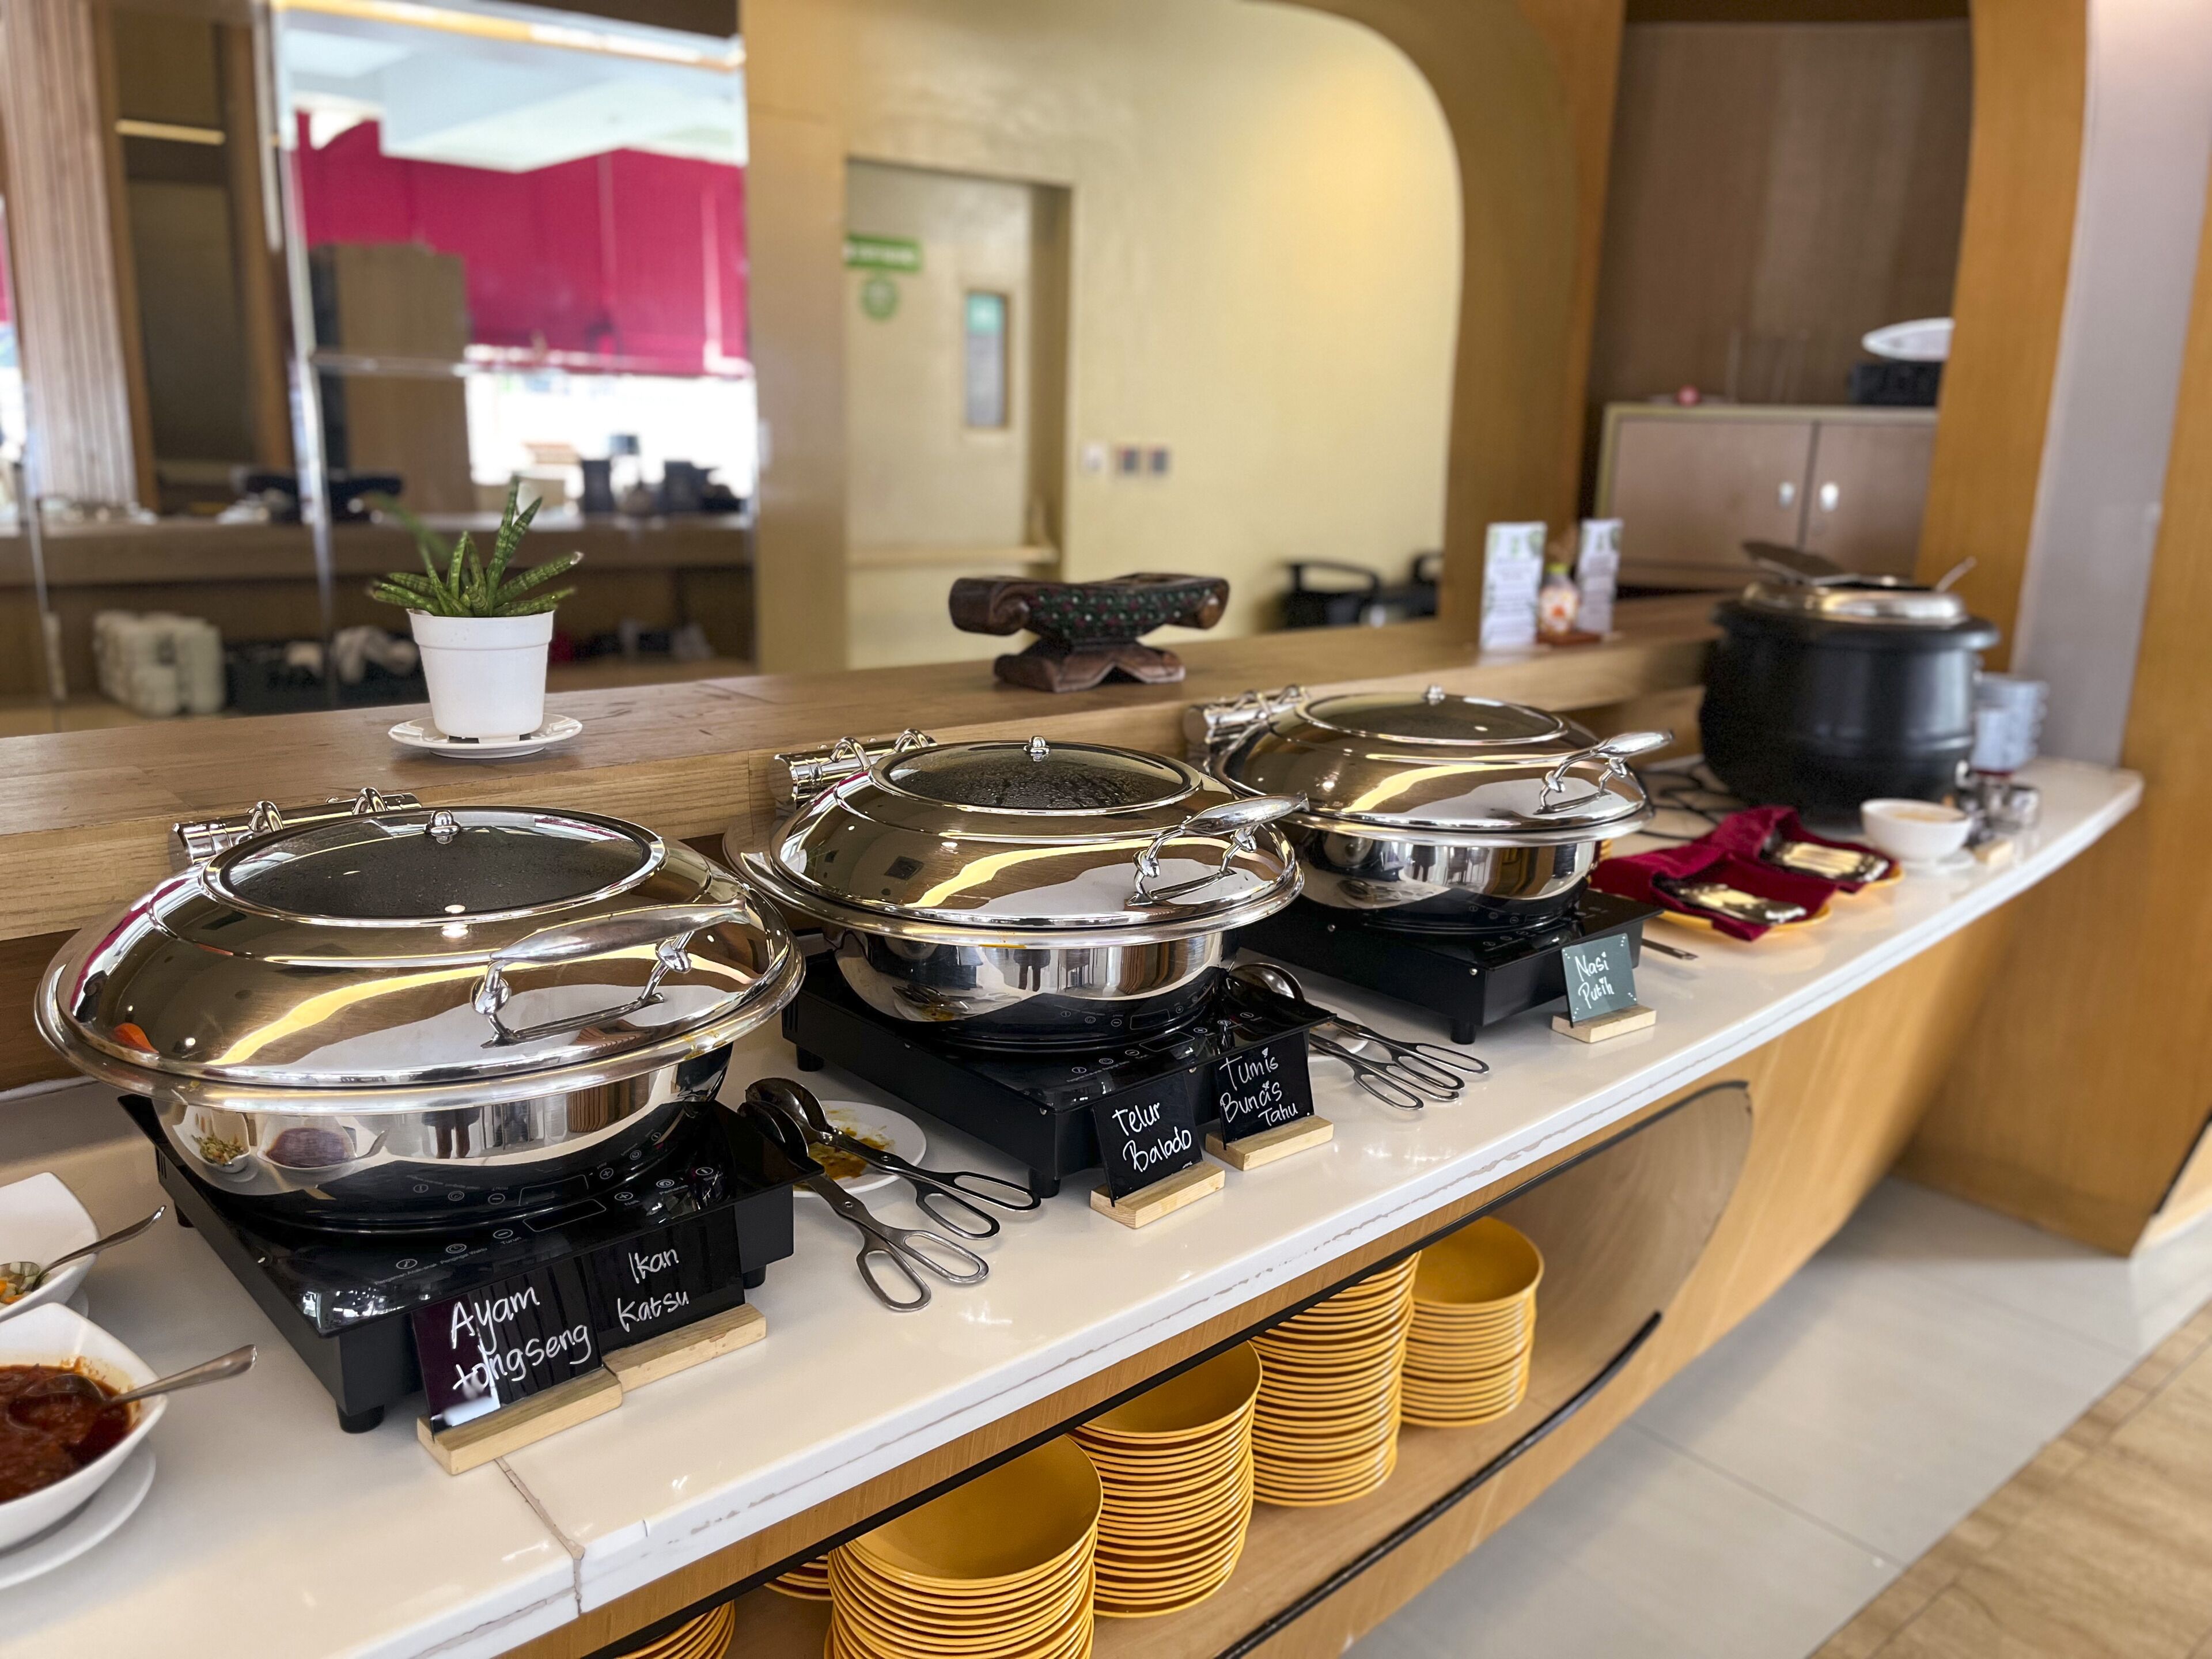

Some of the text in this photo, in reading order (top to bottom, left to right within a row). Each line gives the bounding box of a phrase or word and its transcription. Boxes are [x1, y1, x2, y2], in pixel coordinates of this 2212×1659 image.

[1574, 951, 1609, 982] Nasi
[1577, 976, 1615, 1009] Putih
[1219, 1047, 1279, 1090] Tumis
[1112, 1102, 1160, 1137] Telur
[1220, 1080, 1282, 1123] Buncis
[1258, 1103, 1298, 1126] Tahu
[1123, 1126, 1192, 1172] Balado
[628, 1248, 679, 1284] Ikan
[452, 1286, 540, 1355] Ayam
[617, 1290, 690, 1332] Katsu
